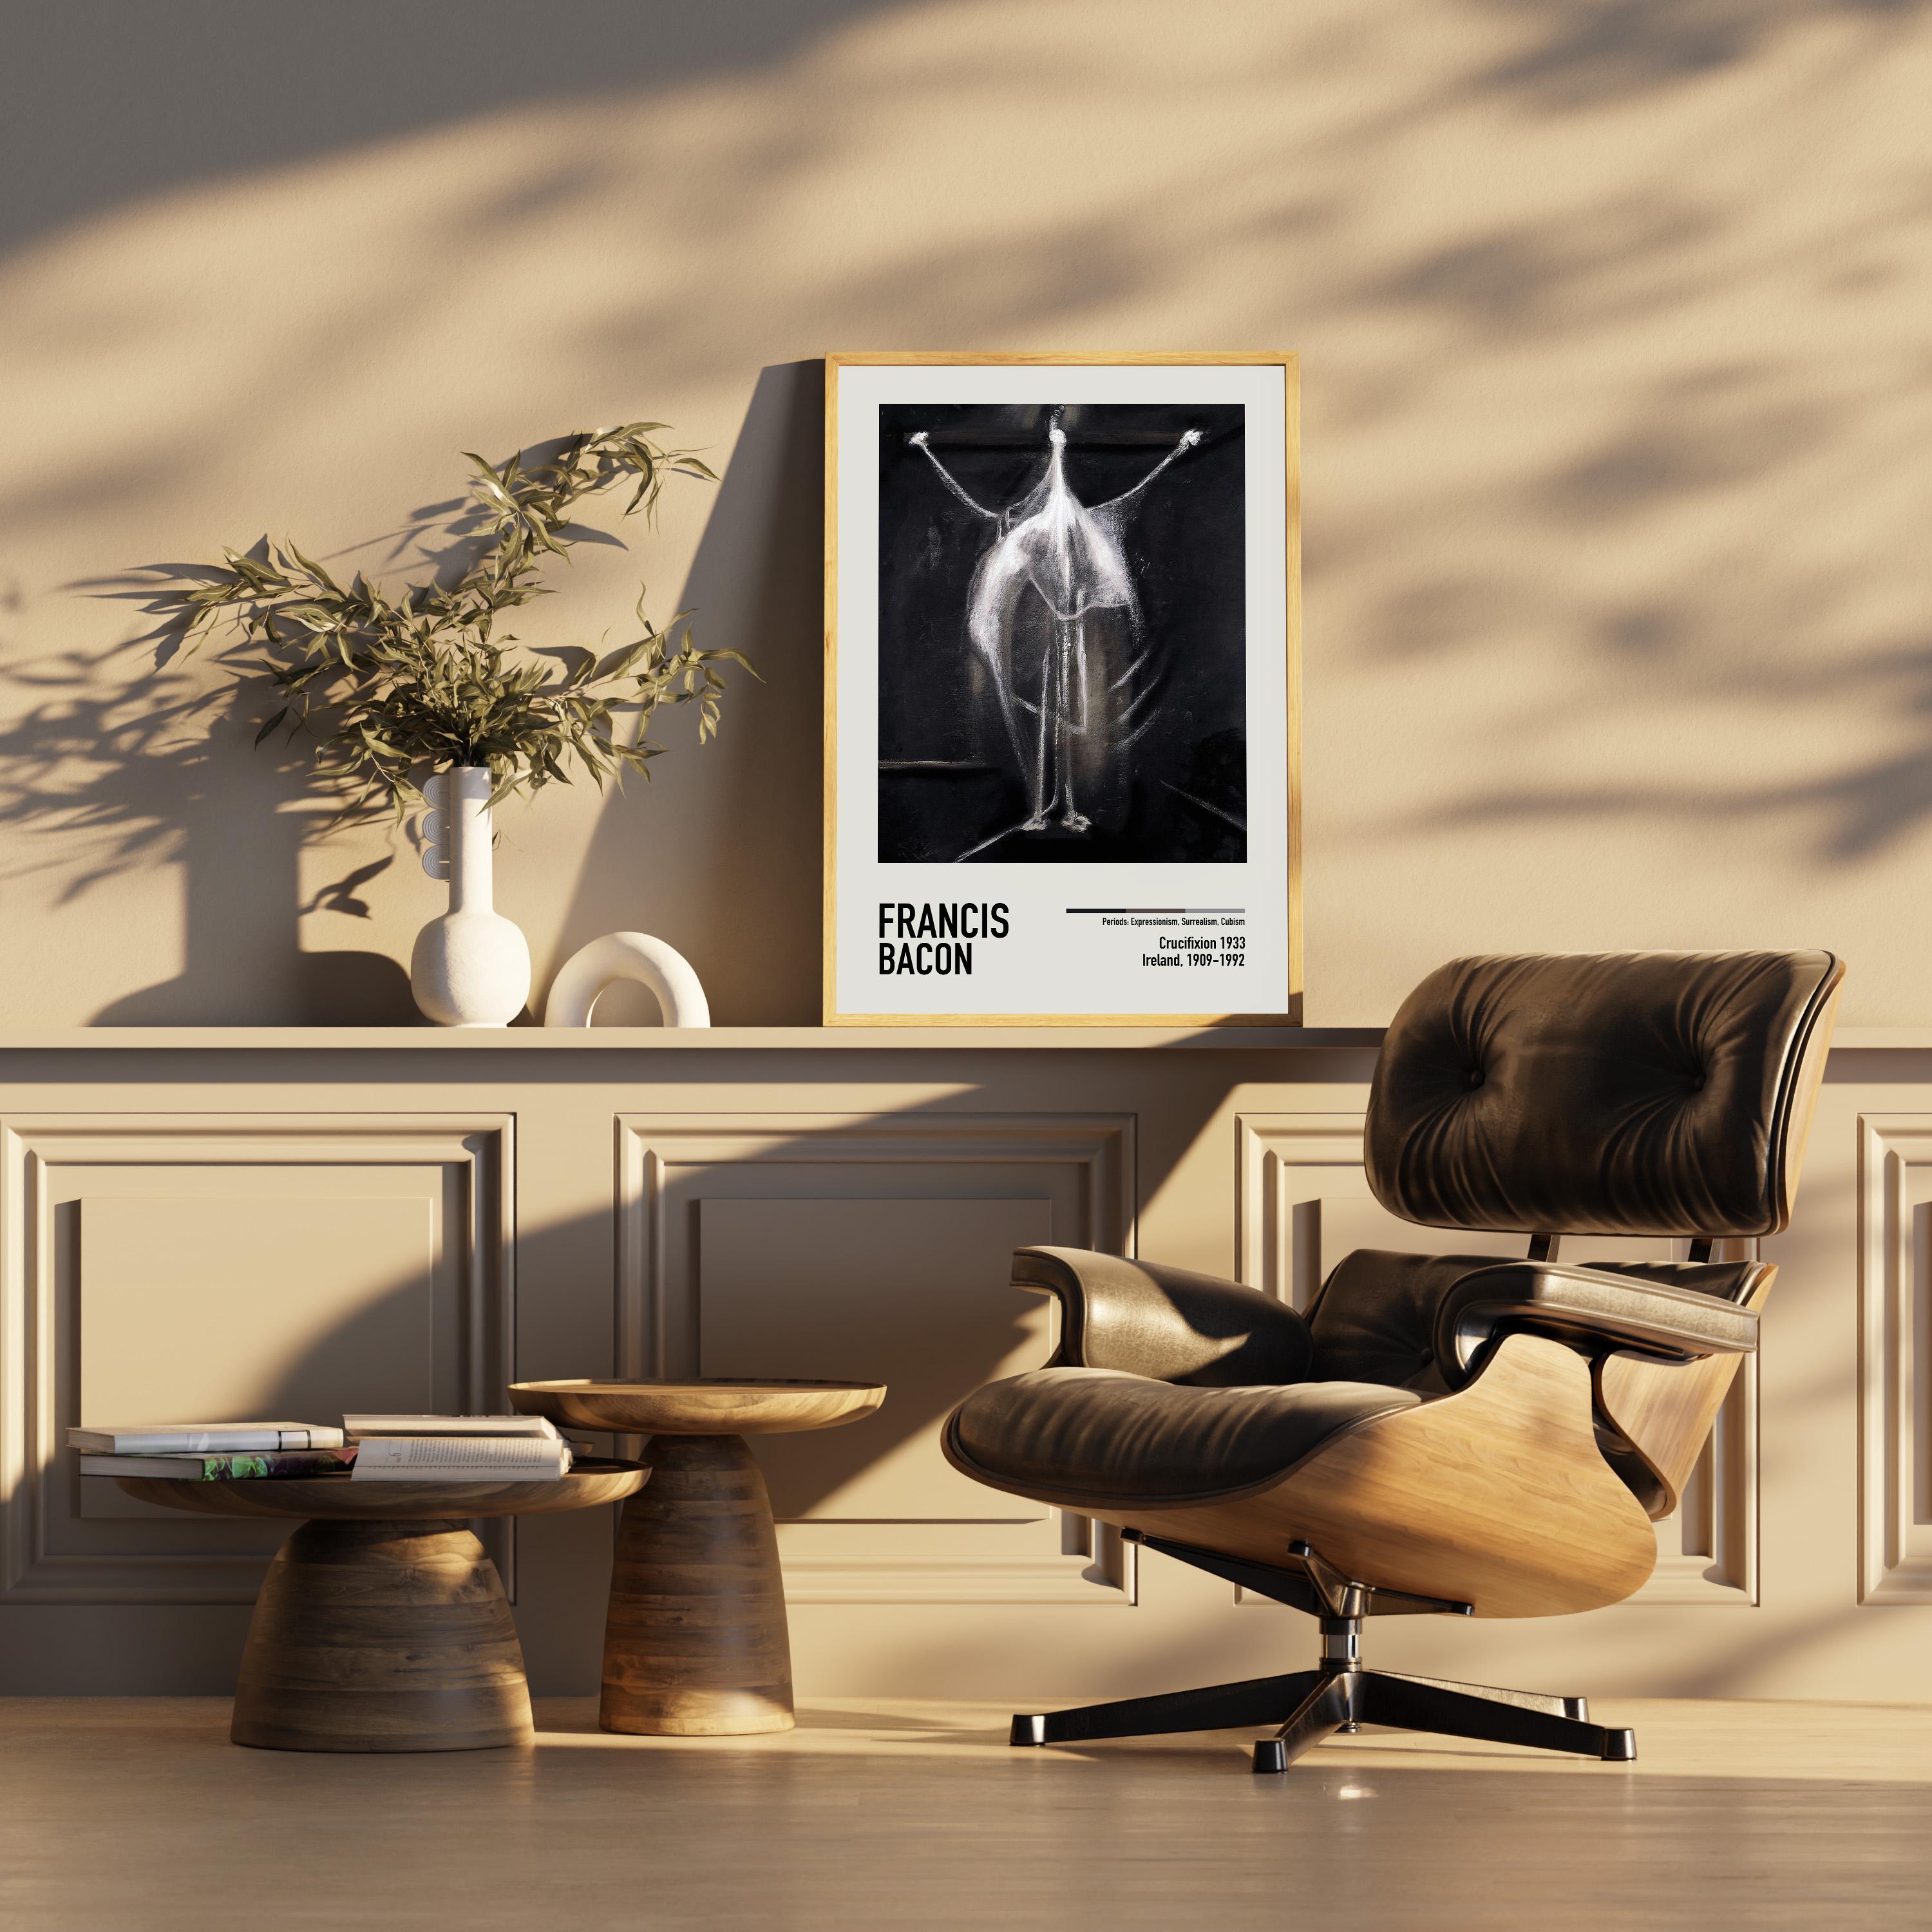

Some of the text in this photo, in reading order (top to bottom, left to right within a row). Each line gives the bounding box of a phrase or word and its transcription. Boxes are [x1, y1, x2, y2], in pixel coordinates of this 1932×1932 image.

[879, 903, 1009, 938] FRANCIS
[1131, 918, 1180, 927] Expressionism,
[1182, 918, 1219, 926] Surrealism,
[1160, 936, 1245, 949] Crucifixion 1933
[880, 943, 972, 975] BACON
[1143, 954, 1245, 967] Ireland, 1909-1992
